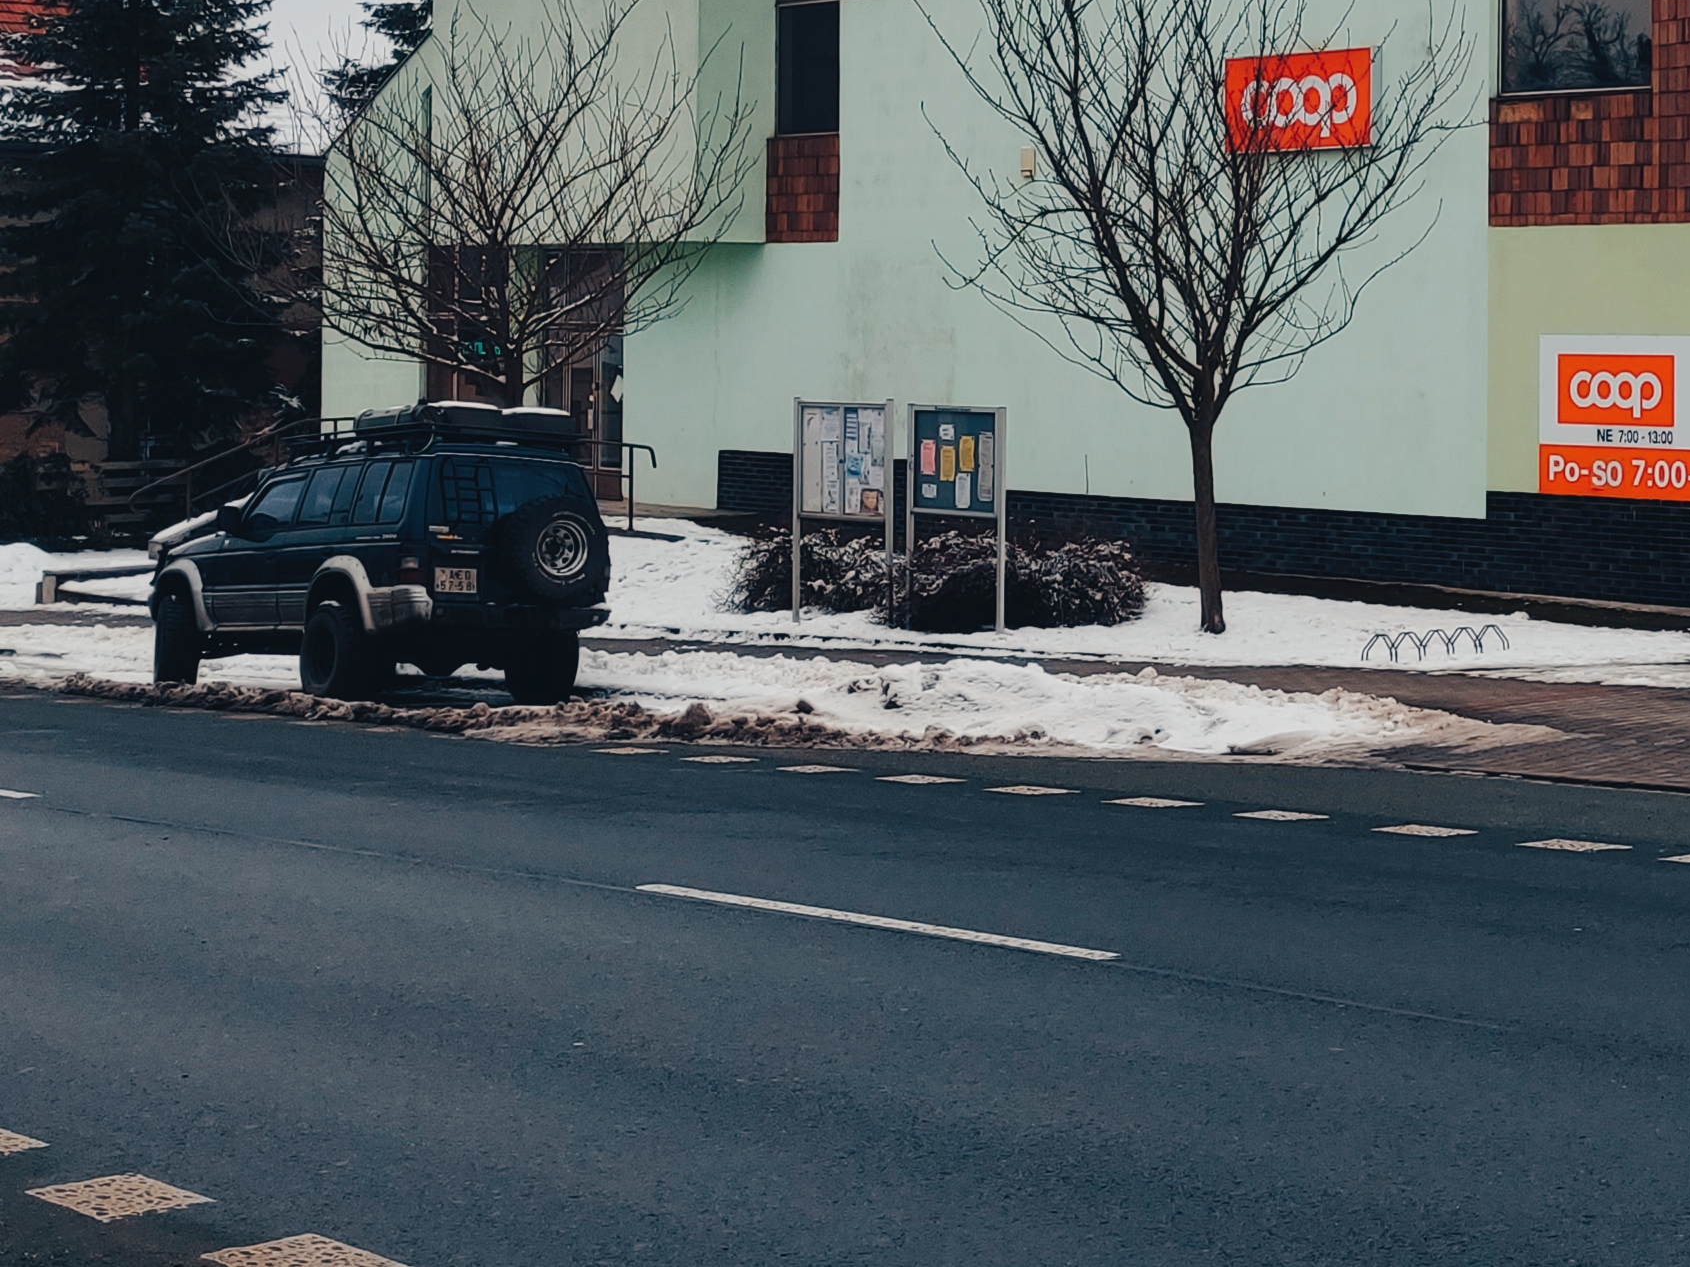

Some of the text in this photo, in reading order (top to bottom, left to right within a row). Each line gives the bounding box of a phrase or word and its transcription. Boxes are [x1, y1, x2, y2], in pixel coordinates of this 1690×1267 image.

[1240, 72, 1358, 138] coop
[1569, 370, 1662, 419] coop
[1596, 428, 1613, 442] NE
[1618, 429, 1639, 443] 7:00
[1647, 430, 1673, 445] 13:00
